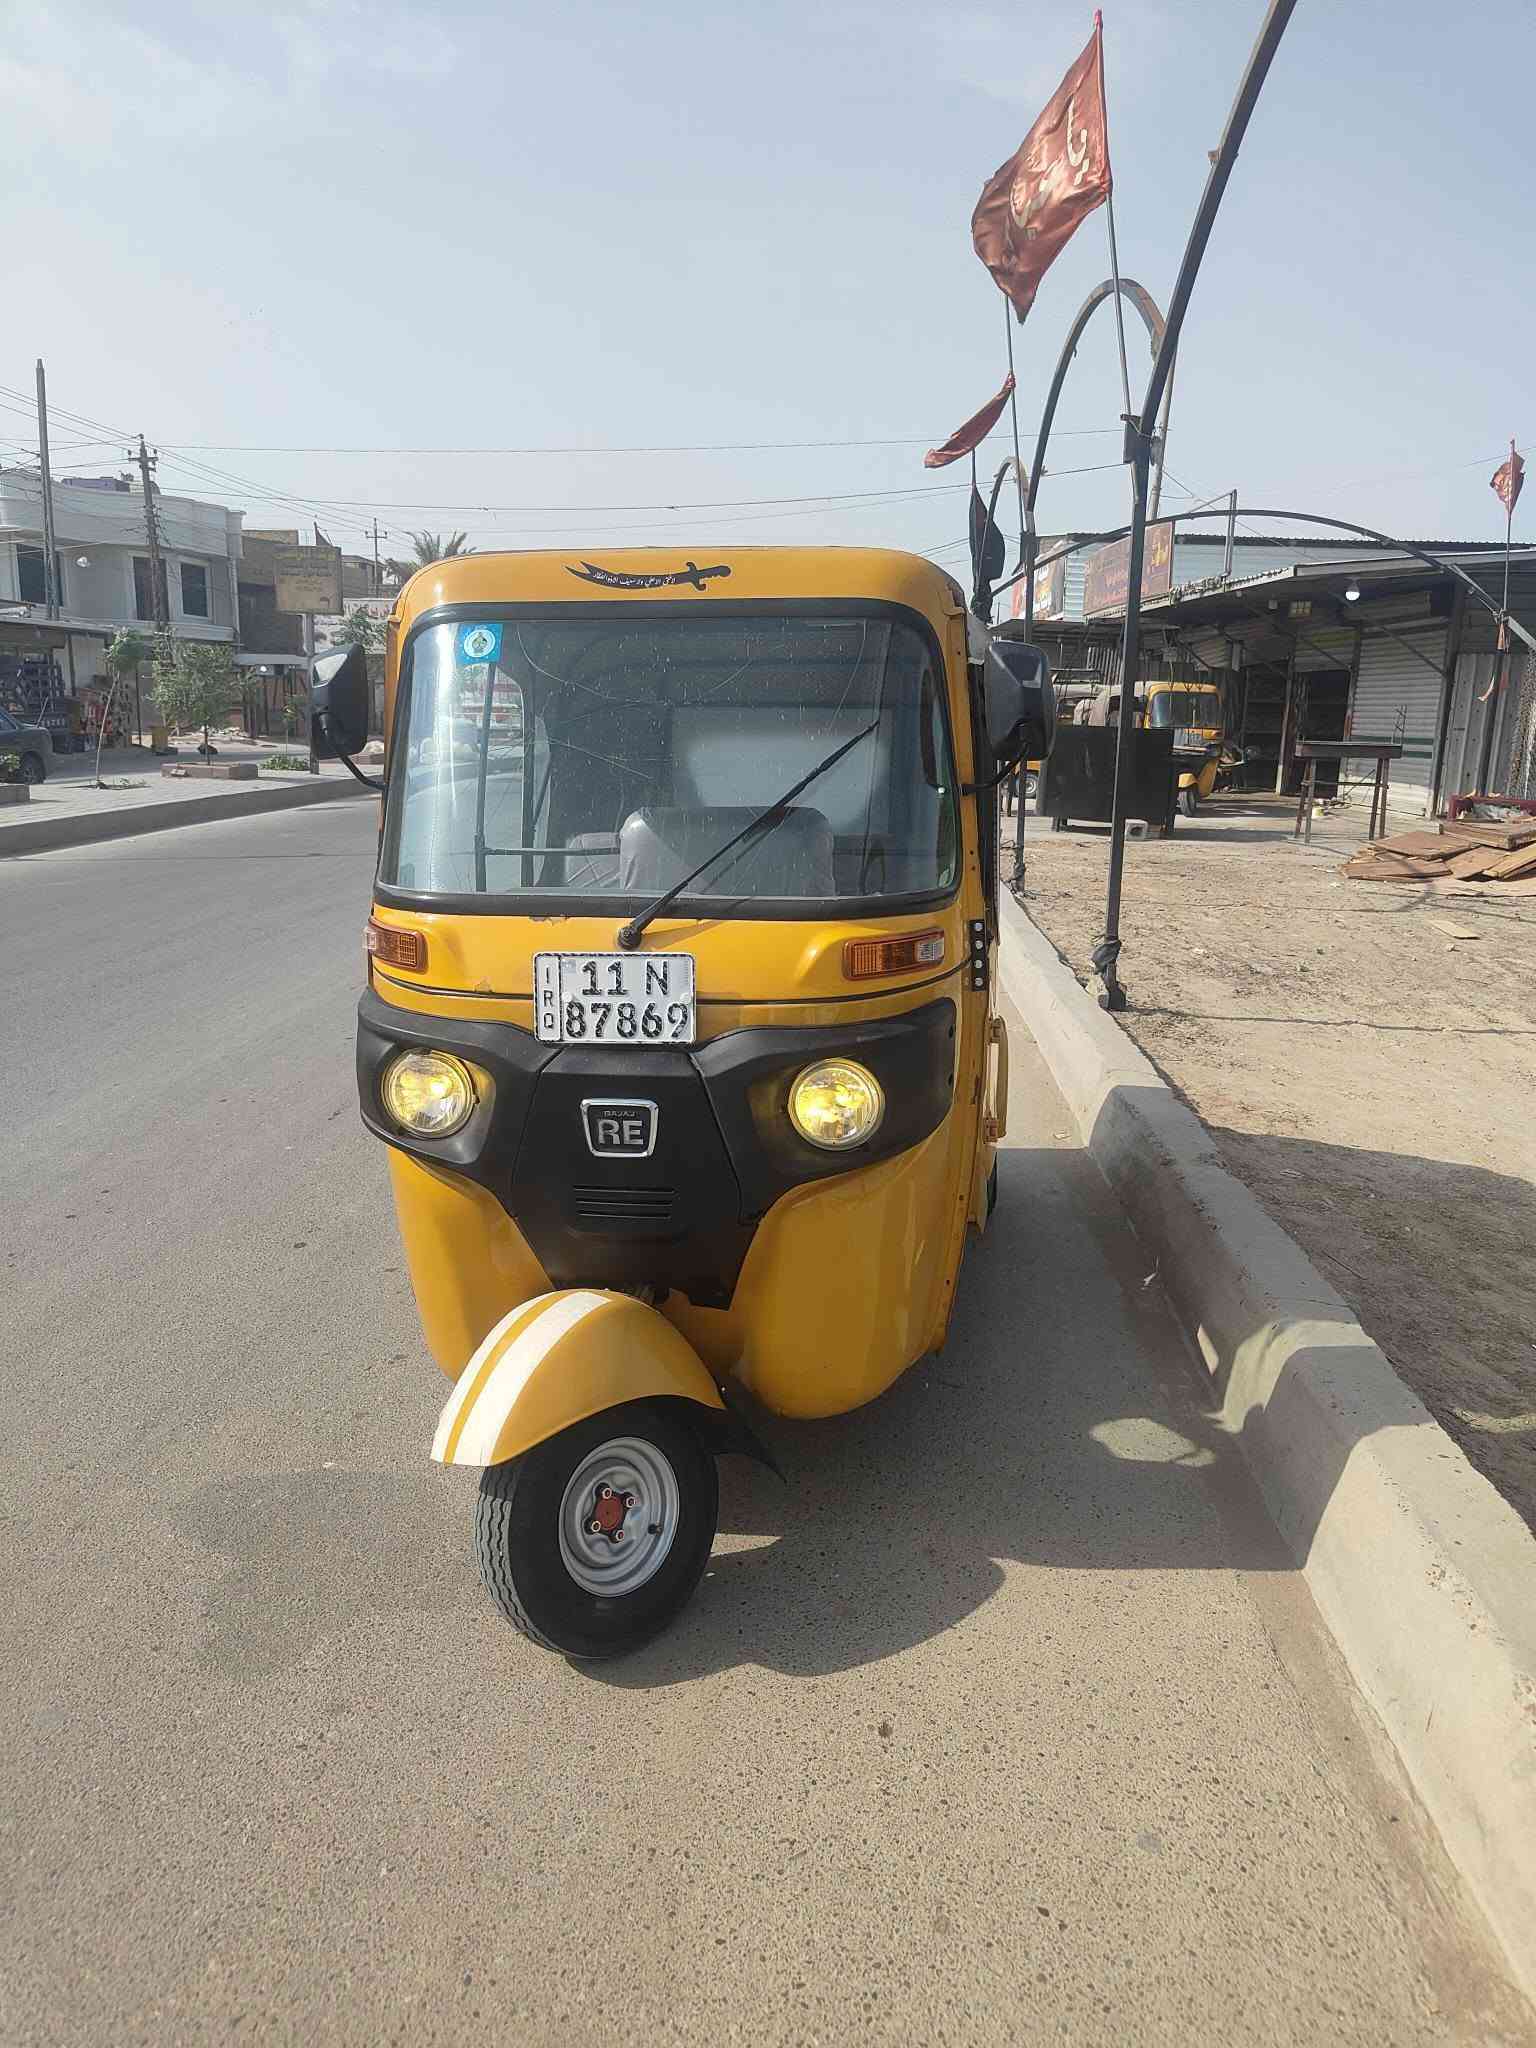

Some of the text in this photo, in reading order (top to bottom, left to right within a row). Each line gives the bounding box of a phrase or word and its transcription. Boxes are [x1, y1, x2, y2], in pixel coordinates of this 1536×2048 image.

[582, 961, 669, 996] 11 N
[566, 1001, 689, 1039] 87869
[598, 1119, 644, 1145] RE
